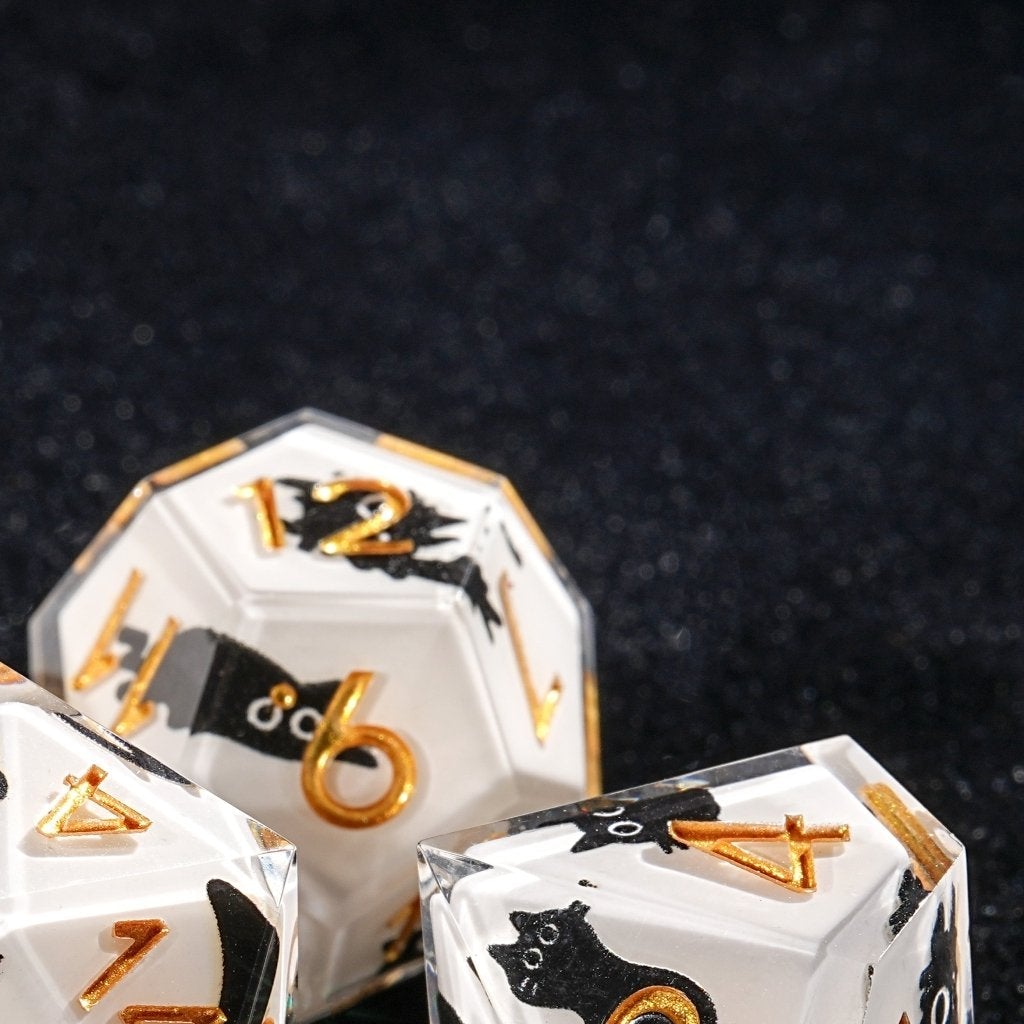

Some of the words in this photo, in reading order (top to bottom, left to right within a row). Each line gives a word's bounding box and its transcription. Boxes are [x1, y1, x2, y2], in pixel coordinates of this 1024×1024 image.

[232, 474, 416, 556] 12
[69, 568, 180, 736] 11
[35, 763, 153, 840] 4
[666, 812, 852, 894] 4
